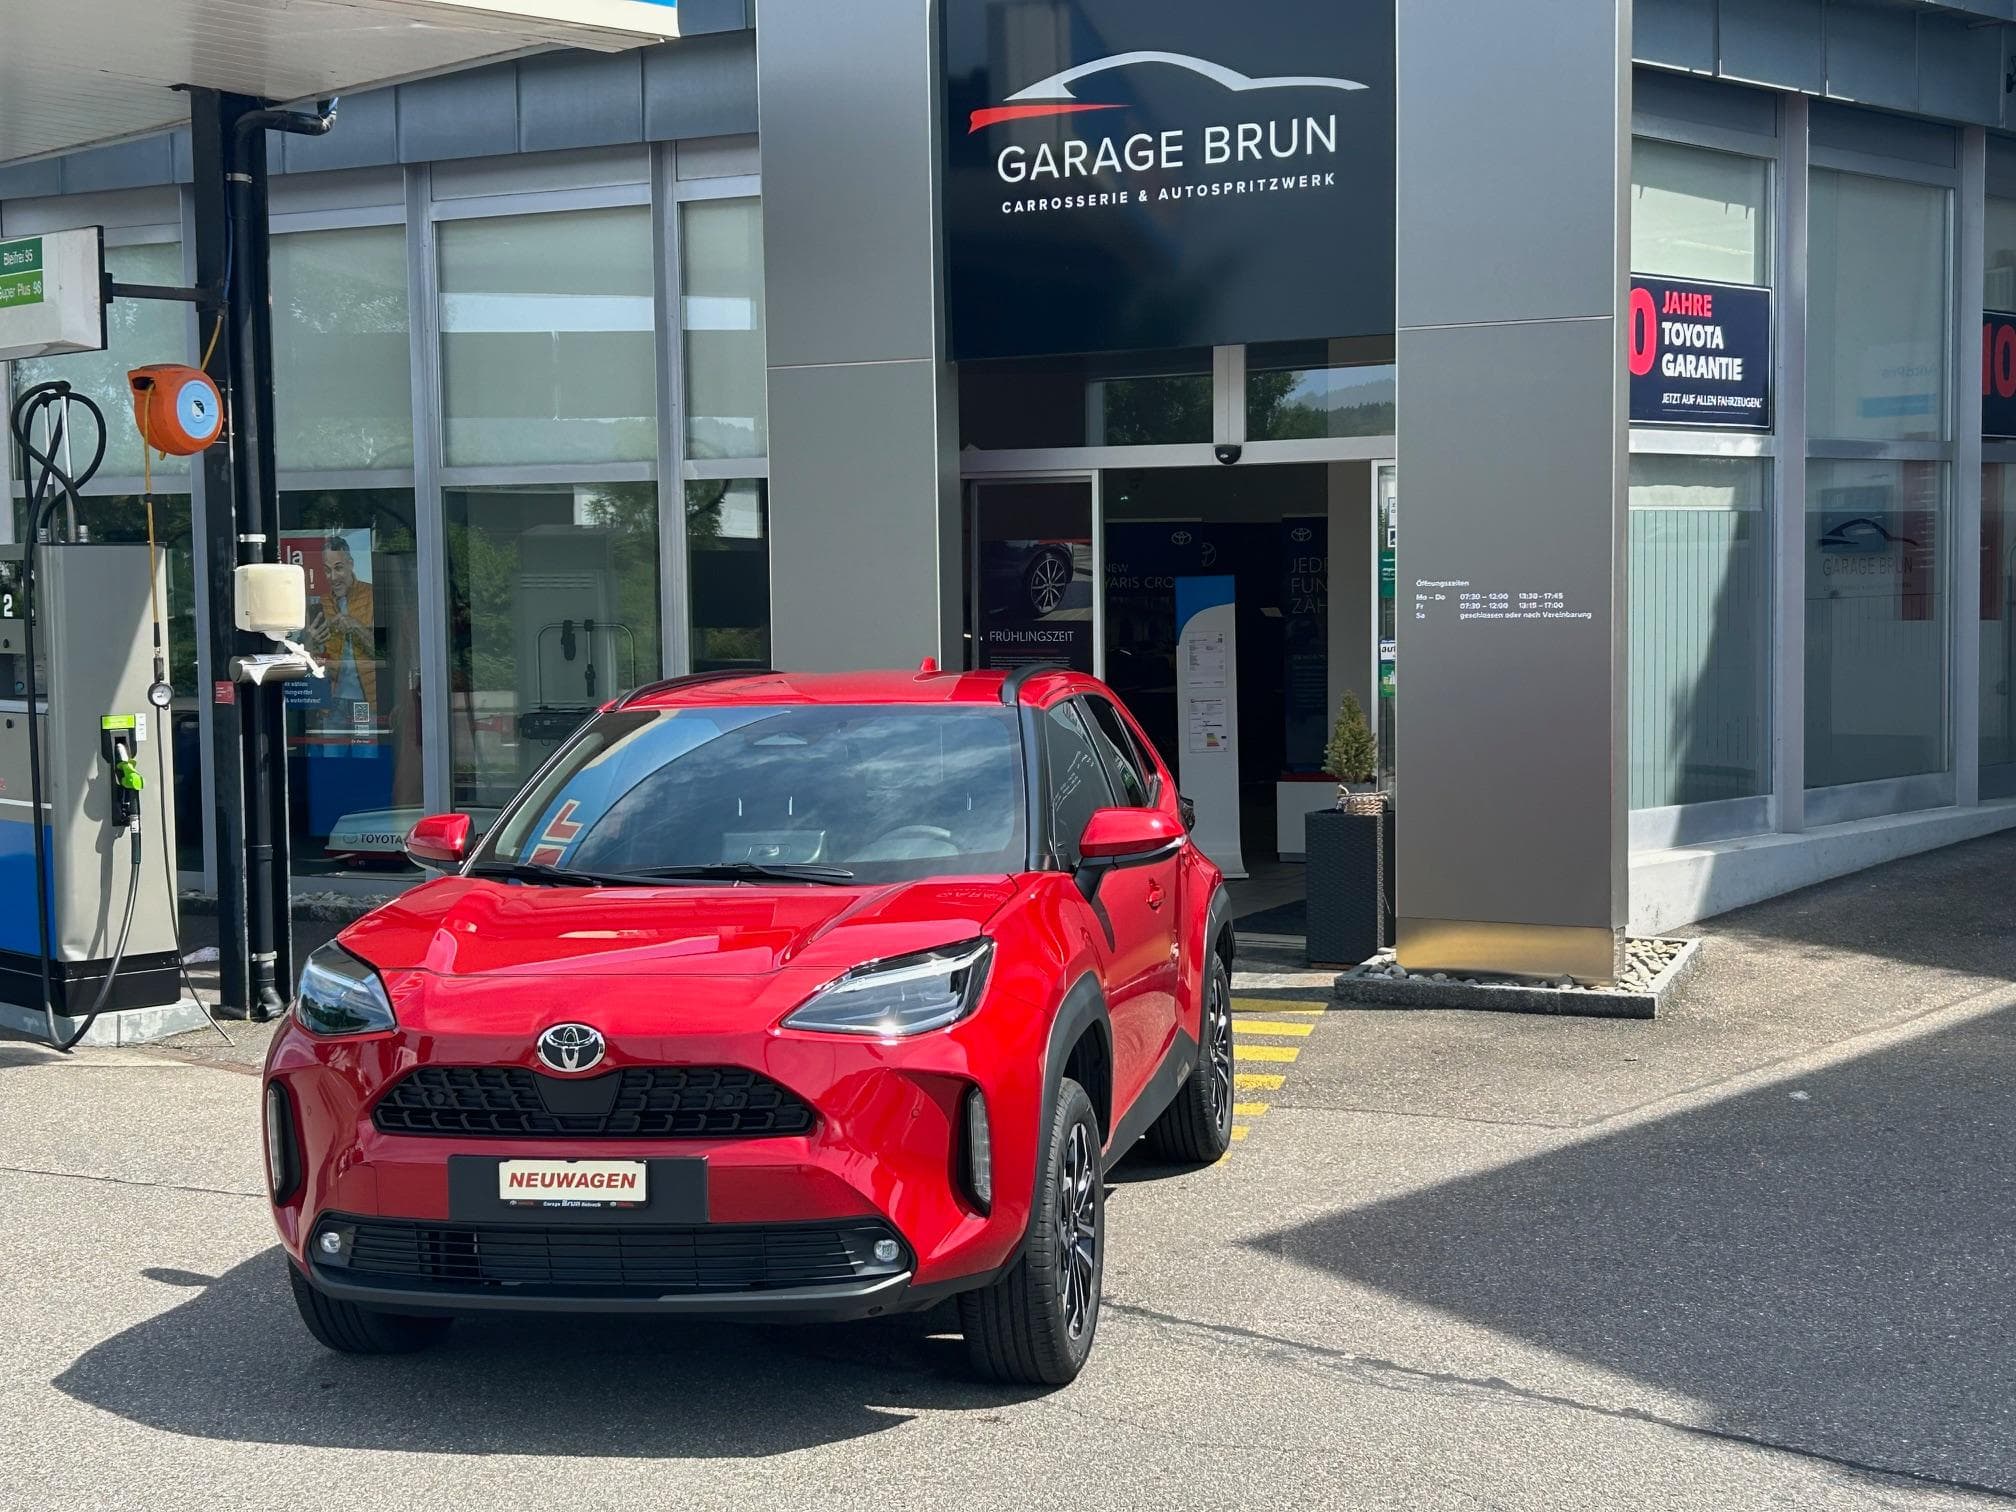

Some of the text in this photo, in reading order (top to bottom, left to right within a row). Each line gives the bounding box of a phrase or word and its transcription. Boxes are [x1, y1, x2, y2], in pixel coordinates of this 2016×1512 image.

[997, 114, 1336, 184] GARAGE BRUN
[1001, 172, 1336, 214] CARROSSERIE & AUTOSPRITZWERK
[3, 251, 24, 266] Bleifrei
[17, 283, 31, 296] Plus
[1629, 287, 1713, 376] 0 JAHRE
[1661, 321, 1724, 350] TOYOTA
[1661, 353, 1743, 381] GARANTIE
[1662, 393, 1682, 404] JETZT
[1682, 394, 1695, 405] AUF
[1696, 395, 1717, 406] ALLEN
[1822, 556, 1913, 577] GARAGE BRUN
[1104, 576, 1175, 589] YARIS CRO
[1291, 577, 1328, 594] FUN
[3, 593, 14, 618] 2
[1460, 611, 1503, 620] geschlossen
[1542, 611, 1592, 620] Vereinbarung
[989, 629, 1075, 643] FRÜHLINGSZEIT
[360, 833, 401, 845] TOYOTA
[509, 1172, 637, 1189] NEUWAGEN
